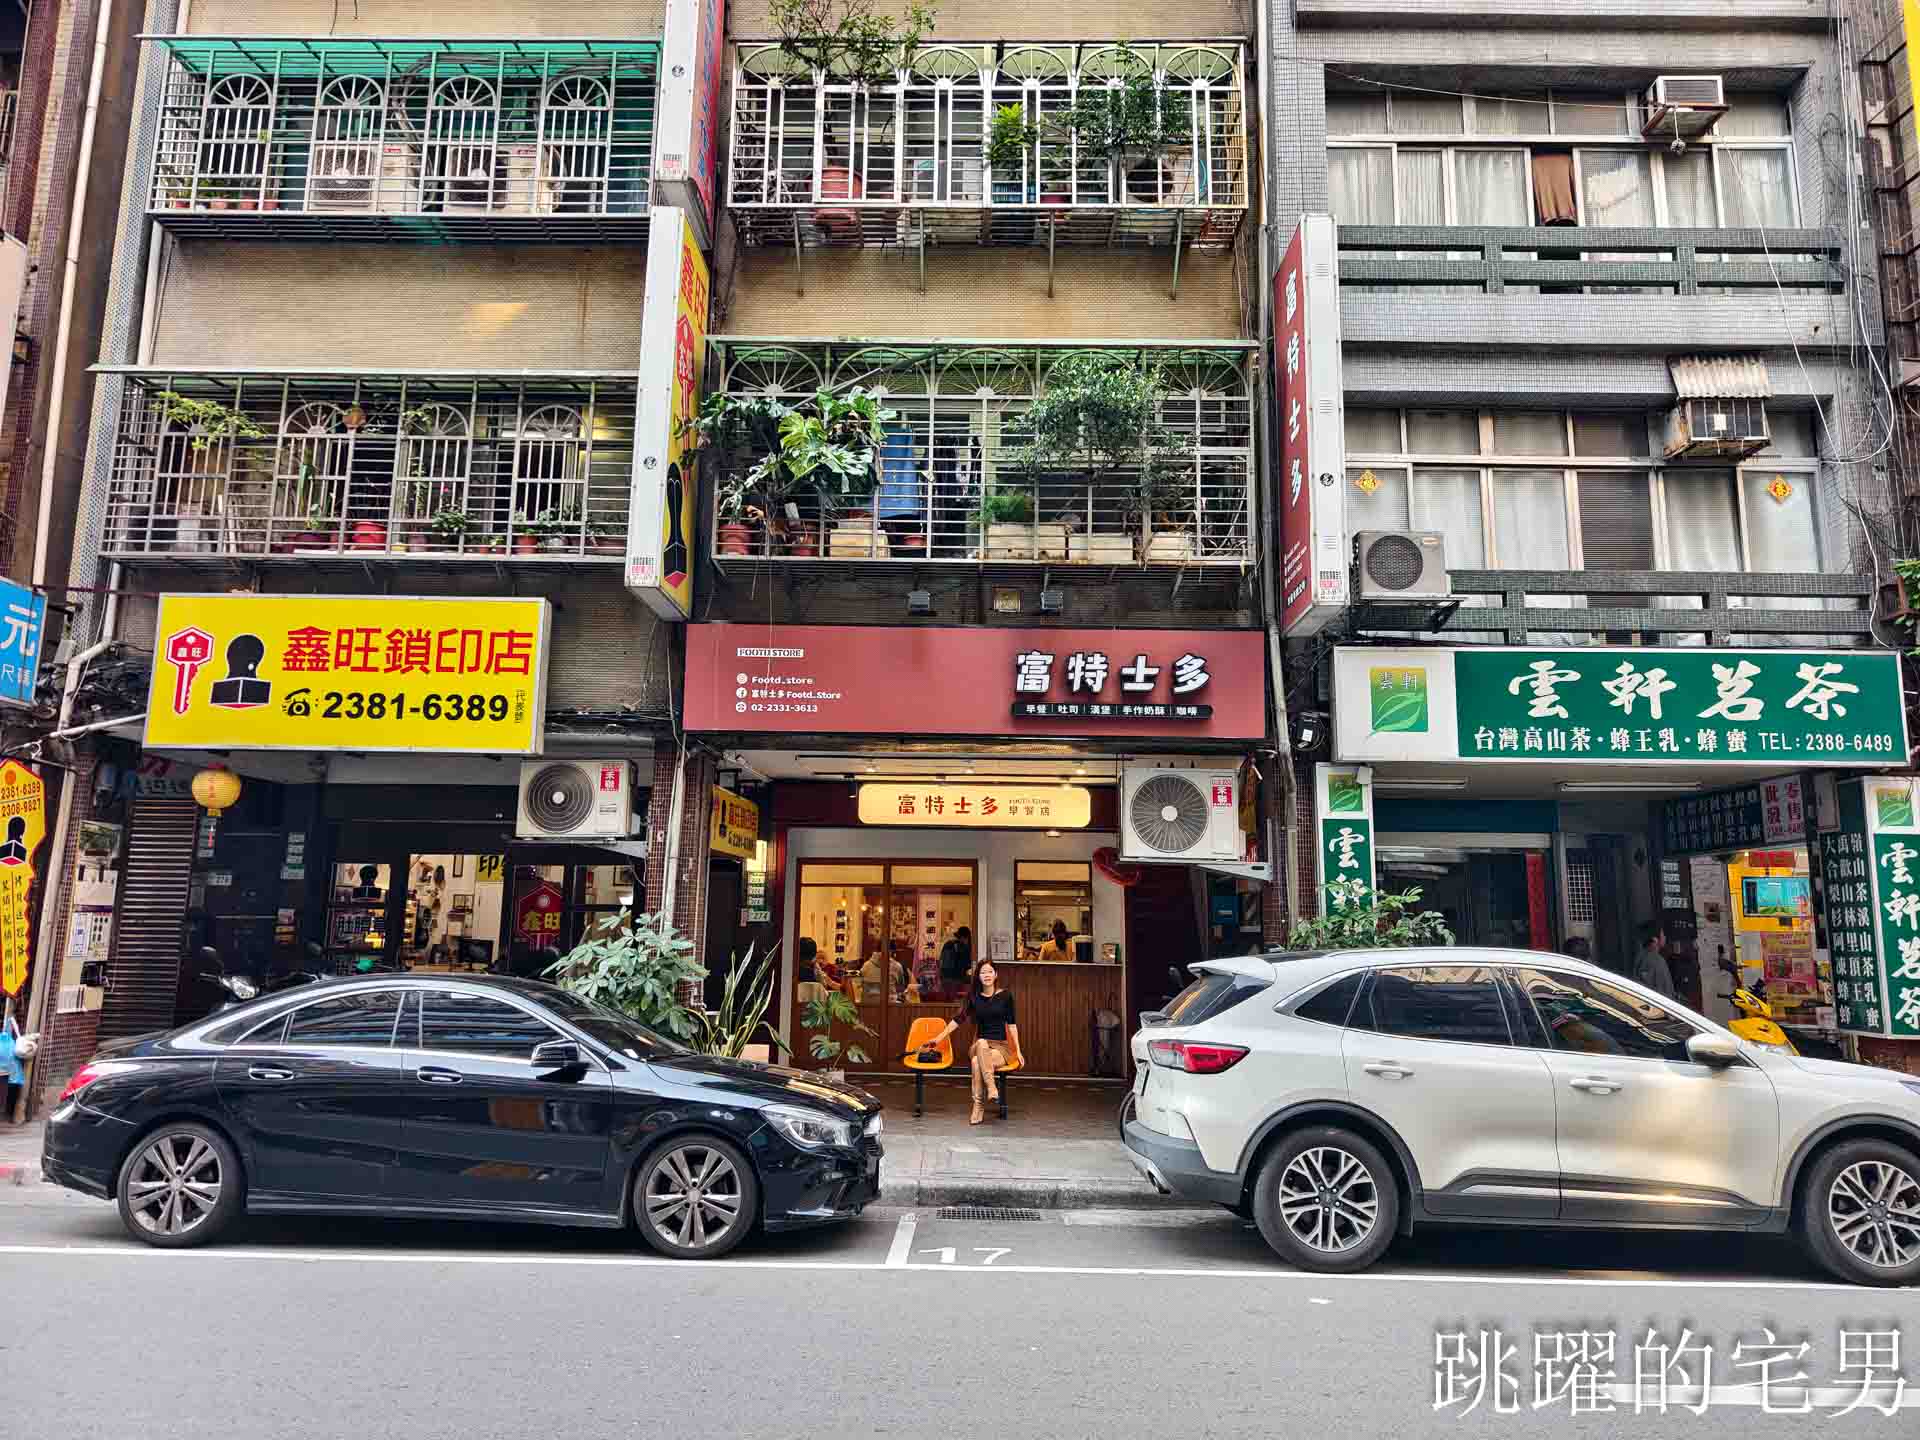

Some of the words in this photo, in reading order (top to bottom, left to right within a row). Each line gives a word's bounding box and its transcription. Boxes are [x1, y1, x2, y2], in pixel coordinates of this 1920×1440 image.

[1286, 269, 1303, 507] 富特士多
[282, 625, 534, 676] 鑫旺鎖印店
[771, 649, 802, 657] STORE
[1015, 651, 1211, 693] 富特士多
[751, 689, 785, 698] 富特士多
[1508, 660, 1860, 720] 雲軒茗茶
[323, 692, 508, 721] 2381-6389
[751, 703, 818, 713] 02-2331-3613
[1026, 704, 1047, 715] 早餐
[1058, 704, 1079, 715] 吐司
[1090, 705, 1111, 715] 漢堡
[1122, 705, 1165, 716] 手作奶酥
[1176, 706, 1199, 717] 咖啡
[898, 795, 999, 815] 富特士多
[1829, 882, 1868, 903] 梨山茶
[1831, 907, 1870, 927] 杉林溪
[1833, 931, 1873, 952] 阿里山
[1836, 956, 1875, 977] 凍頂茶
[1837, 980, 1878, 1002] 蜂王乳
